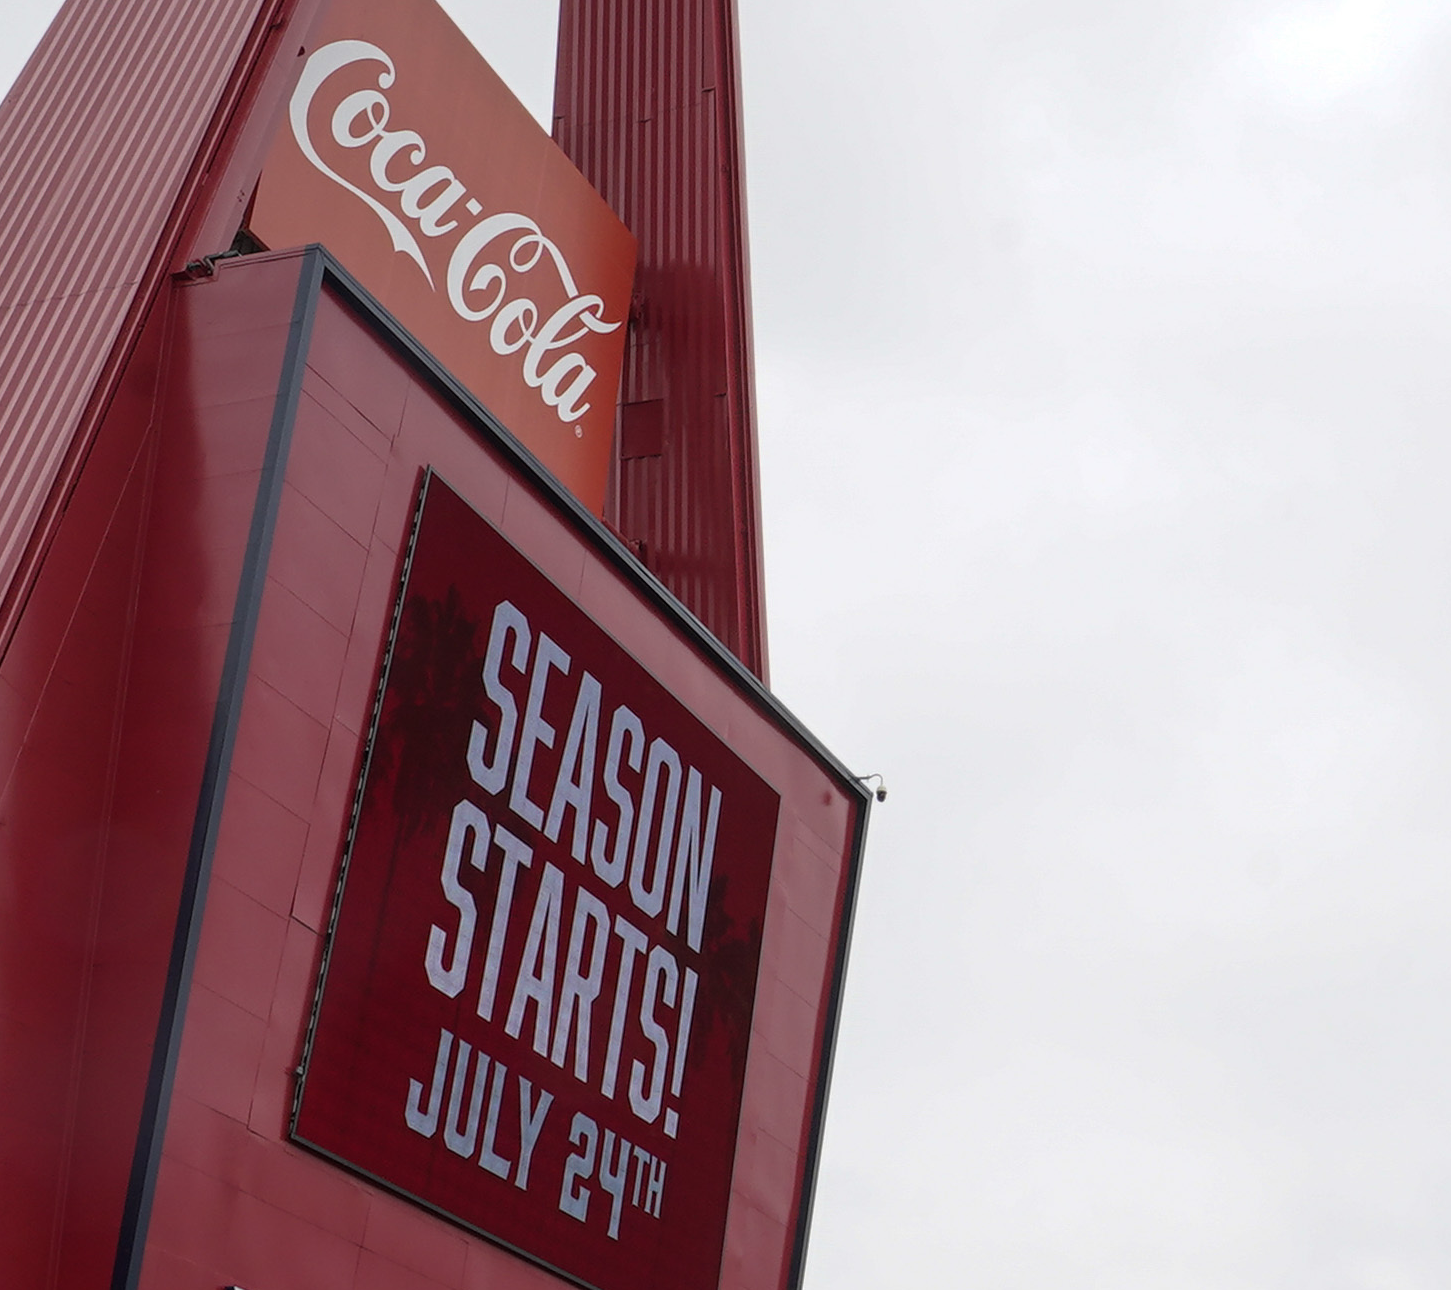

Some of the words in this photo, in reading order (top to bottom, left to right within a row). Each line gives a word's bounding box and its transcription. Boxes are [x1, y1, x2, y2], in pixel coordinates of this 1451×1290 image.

[289, 38, 623, 424] Coca-Cola
[465, 599, 723, 954] SEASON
[403, 1027, 555, 1192] JULY
[423, 798, 699, 1140] STARTS!
